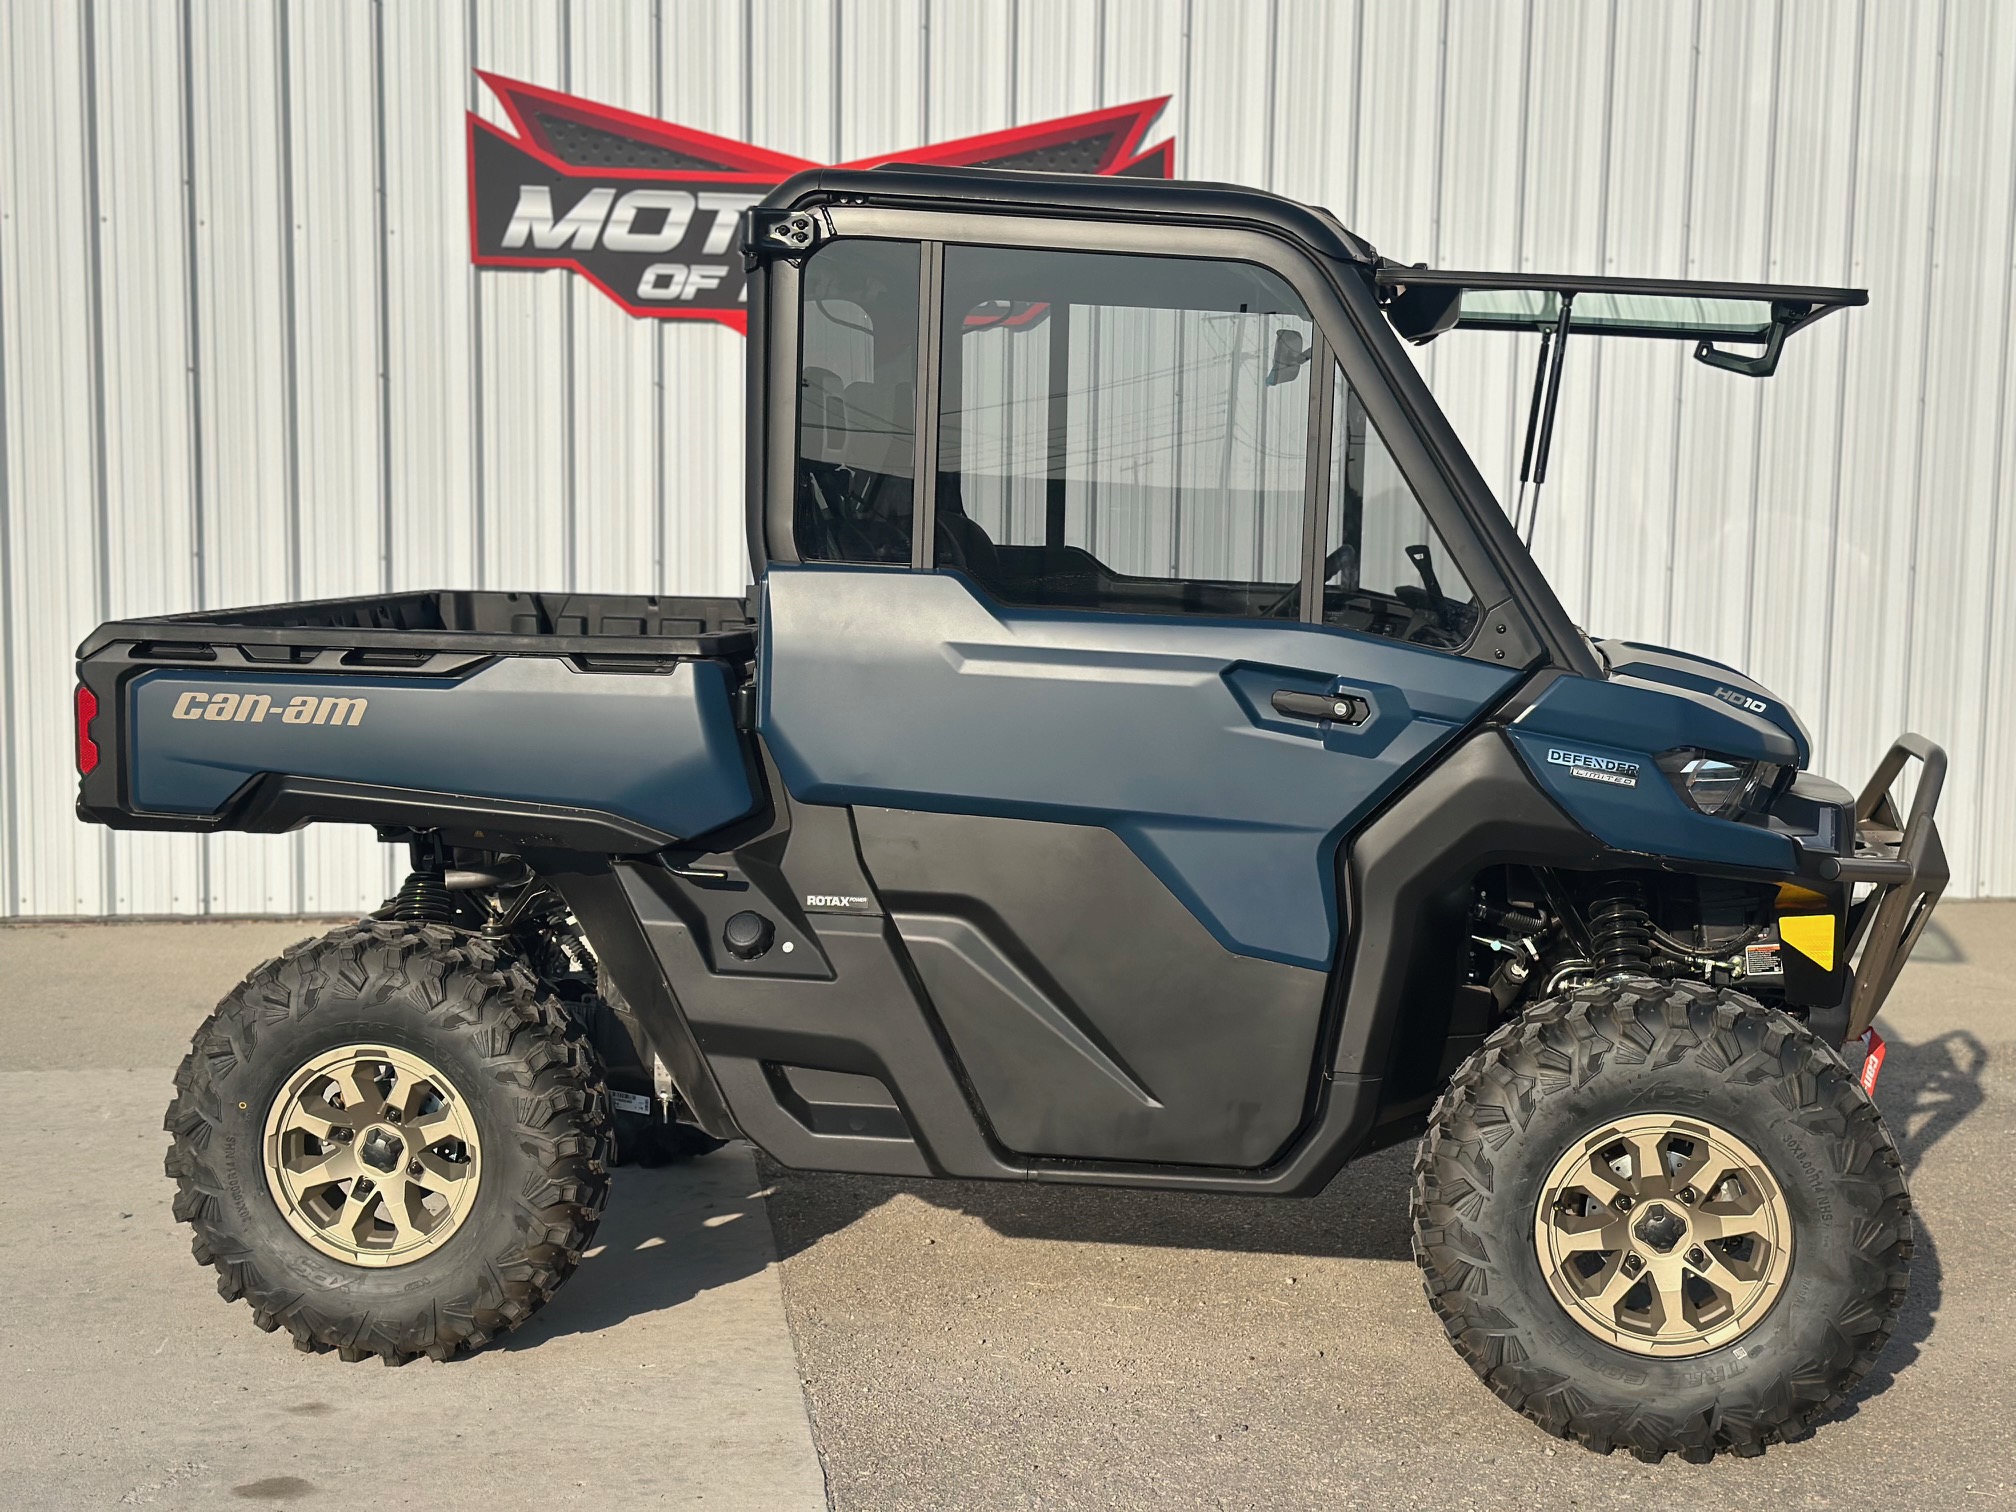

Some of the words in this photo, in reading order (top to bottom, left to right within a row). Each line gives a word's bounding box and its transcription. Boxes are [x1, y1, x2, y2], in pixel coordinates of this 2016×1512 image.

[636, 263, 729, 300] OF
[172, 692, 368, 726] can-am
[1713, 686, 1767, 713] HD10
[1550, 750, 1638, 774] DEFENDER
[1575, 768, 1633, 785] LIMITED
[806, 895, 849, 907] ROTAX
[225, 1136, 236, 1159] NHS
